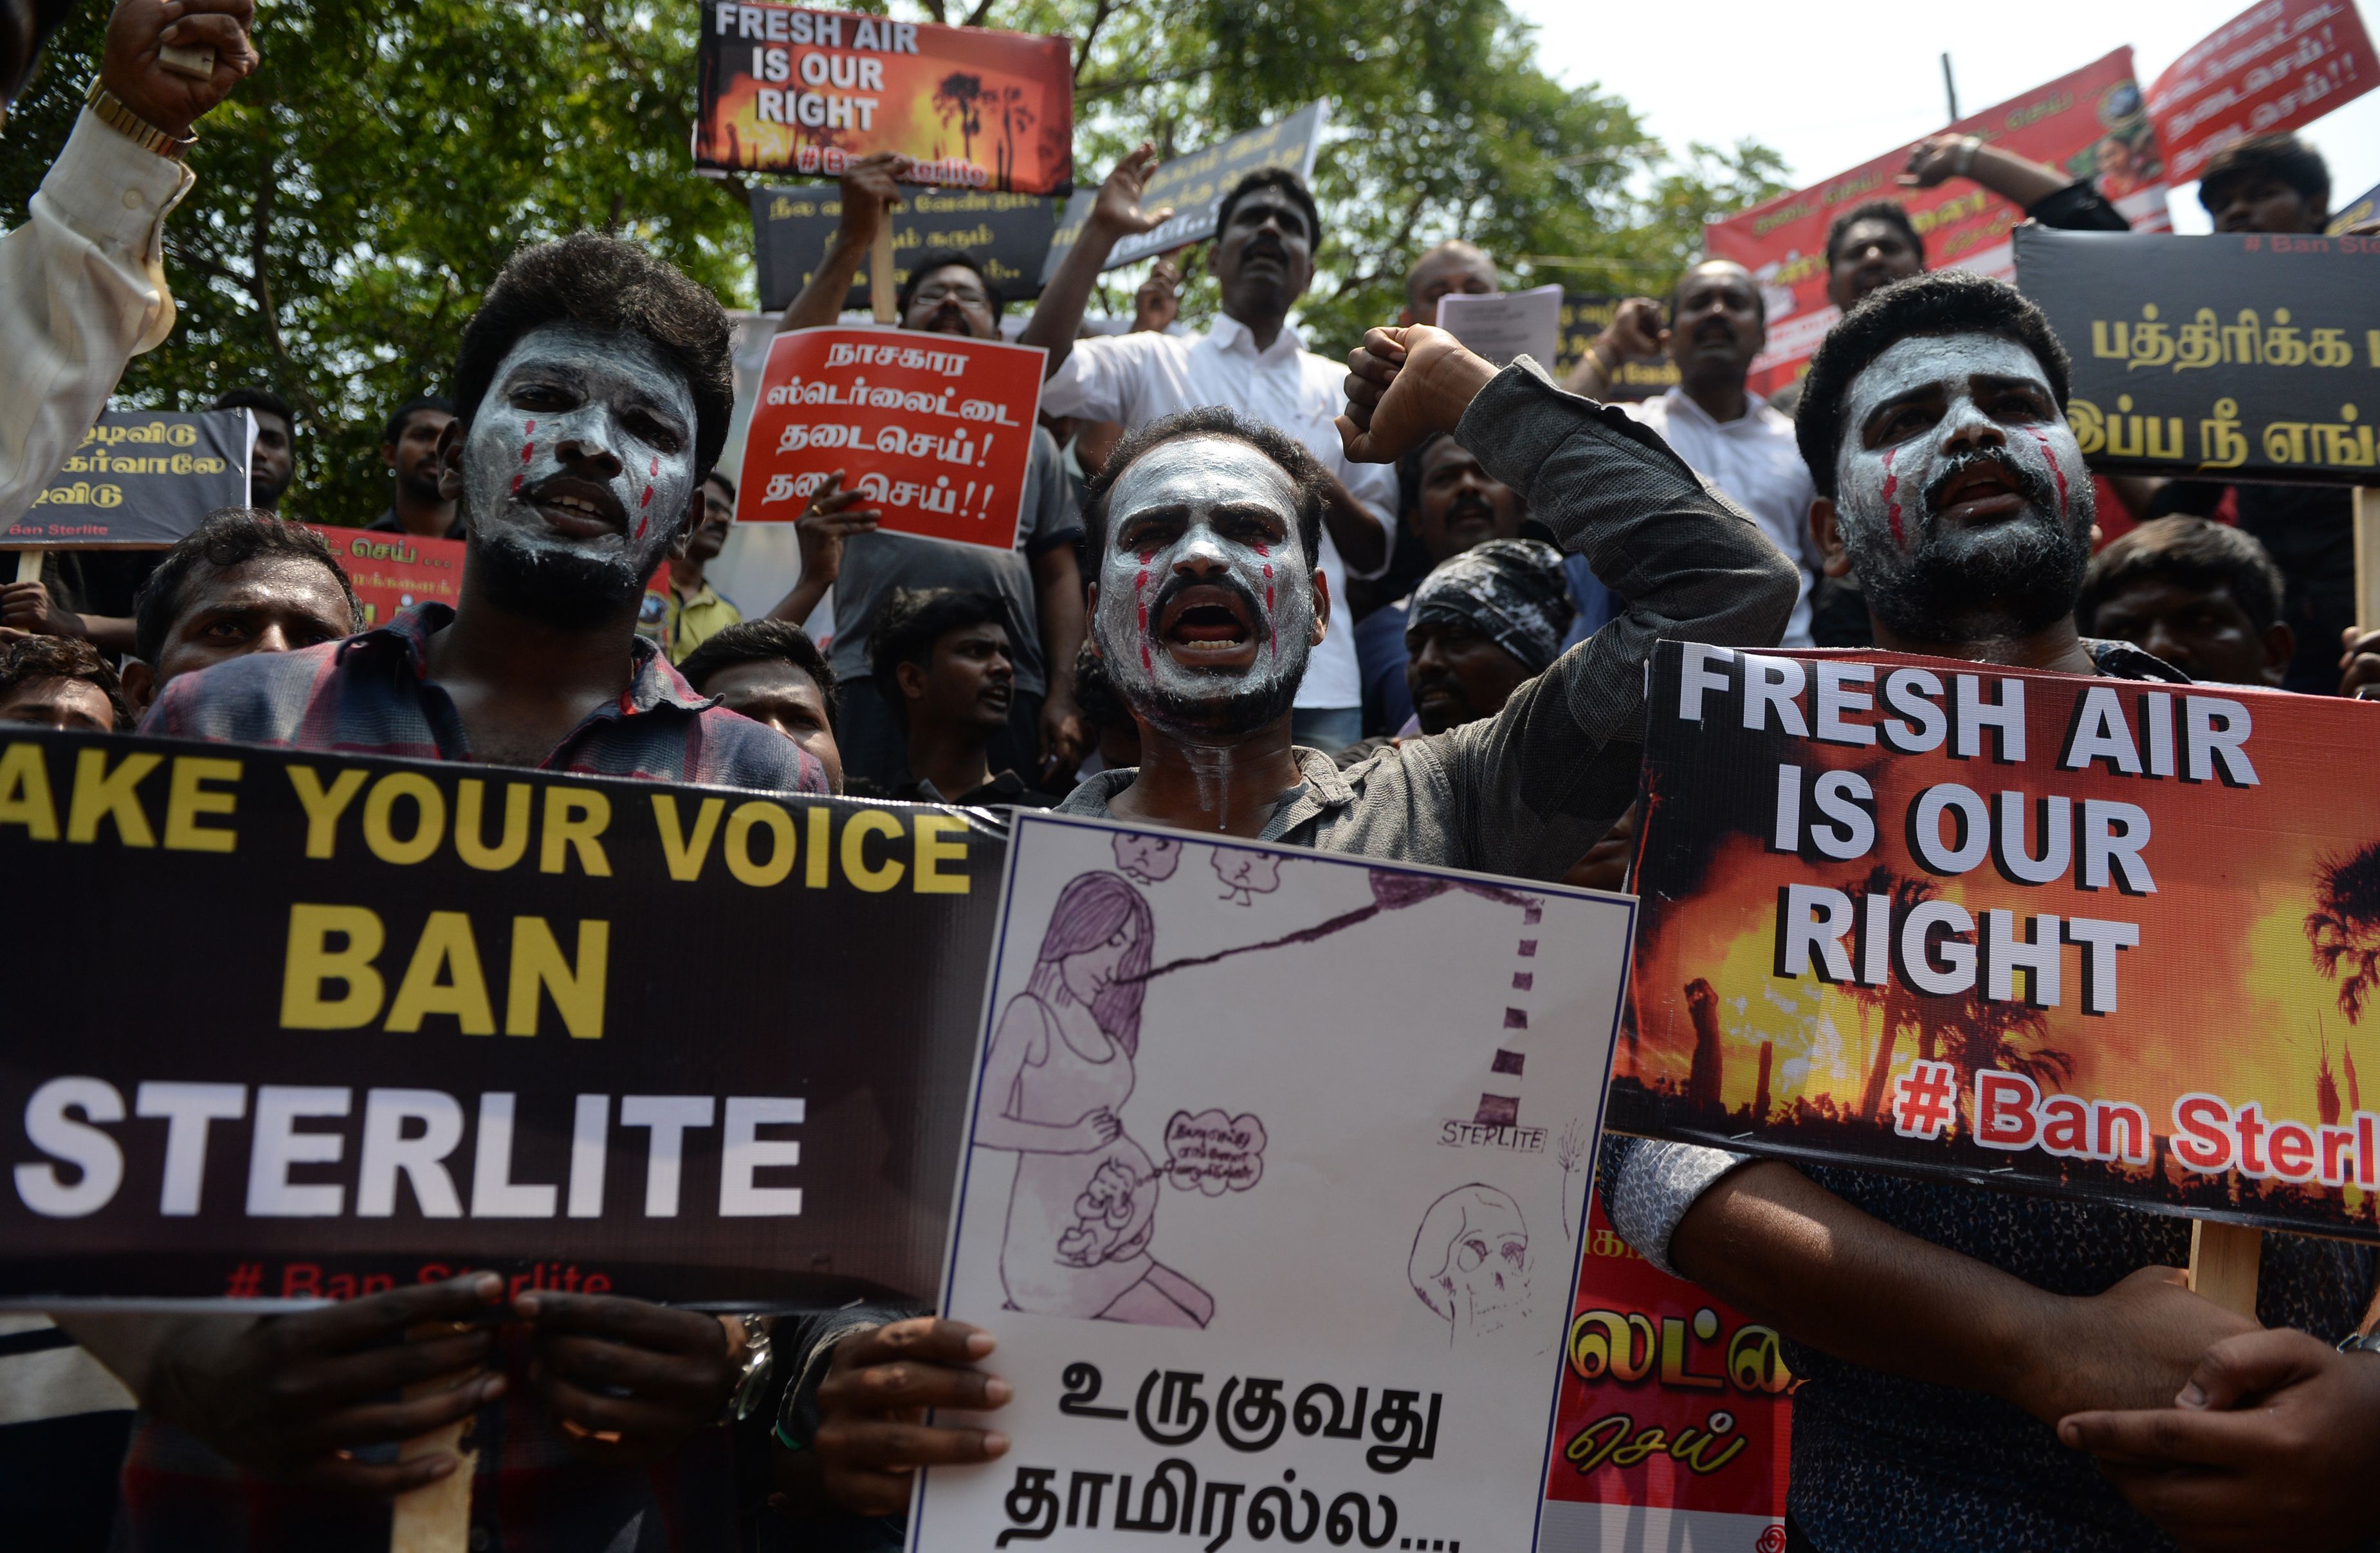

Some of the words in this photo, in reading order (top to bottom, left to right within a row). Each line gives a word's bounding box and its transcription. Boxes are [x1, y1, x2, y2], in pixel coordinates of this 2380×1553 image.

[715, 3, 842, 48] FRESH
[852, 17, 919, 55] AIR
[752, 46, 791, 82] IS
[801, 51, 884, 91] OUR
[756, 87, 879, 132] RIGHT
[895, 154, 987, 187] terlite
[825, 343, 969, 376] நாசகார
[61, 448, 226, 475] கர்வாலே
[776, 423, 994, 468] தடைசெய்!
[1678, 643, 2026, 763] FRESH
[2064, 686, 2261, 786] AIR
[286, 765, 612, 877] YOUR
[651, 795, 971, 894] VOICE
[1771, 763, 1876, 862] IS
[1912, 783, 2159, 895] OUR
[280, 903, 610, 1039] BAN
[1780, 883, 2140, 1015] RIGHT
[14, 1075, 806, 1218] STERLITE
[1977, 1071, 2147, 1162] Ban
[1058, 1361, 1443, 1475] உருகுவது
[1565, 1410, 1748, 1475] செய்
